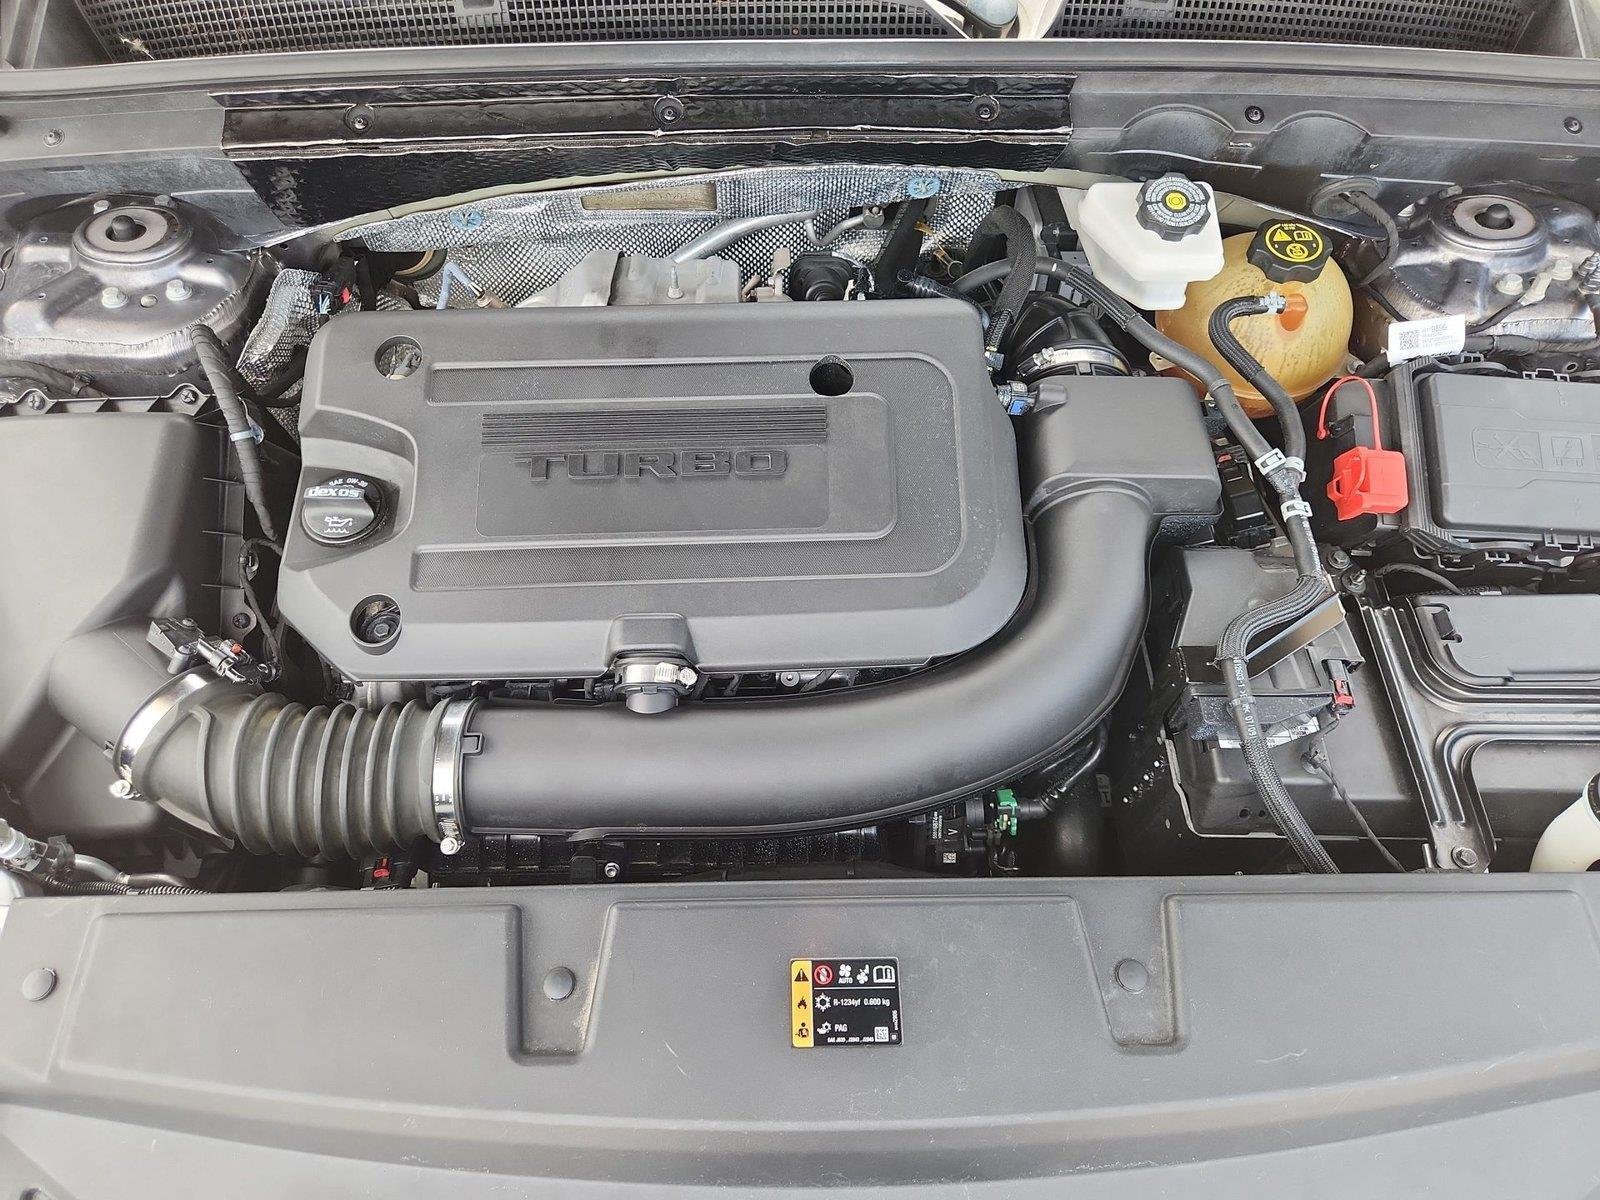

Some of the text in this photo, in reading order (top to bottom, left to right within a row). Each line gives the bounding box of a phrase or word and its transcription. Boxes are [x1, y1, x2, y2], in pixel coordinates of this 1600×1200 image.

[514, 449, 790, 482] TURBO
[308, 486, 360, 498] dexos
[833, 997, 861, 1007] R-1234yf
[882, 998, 890, 1007] kg
